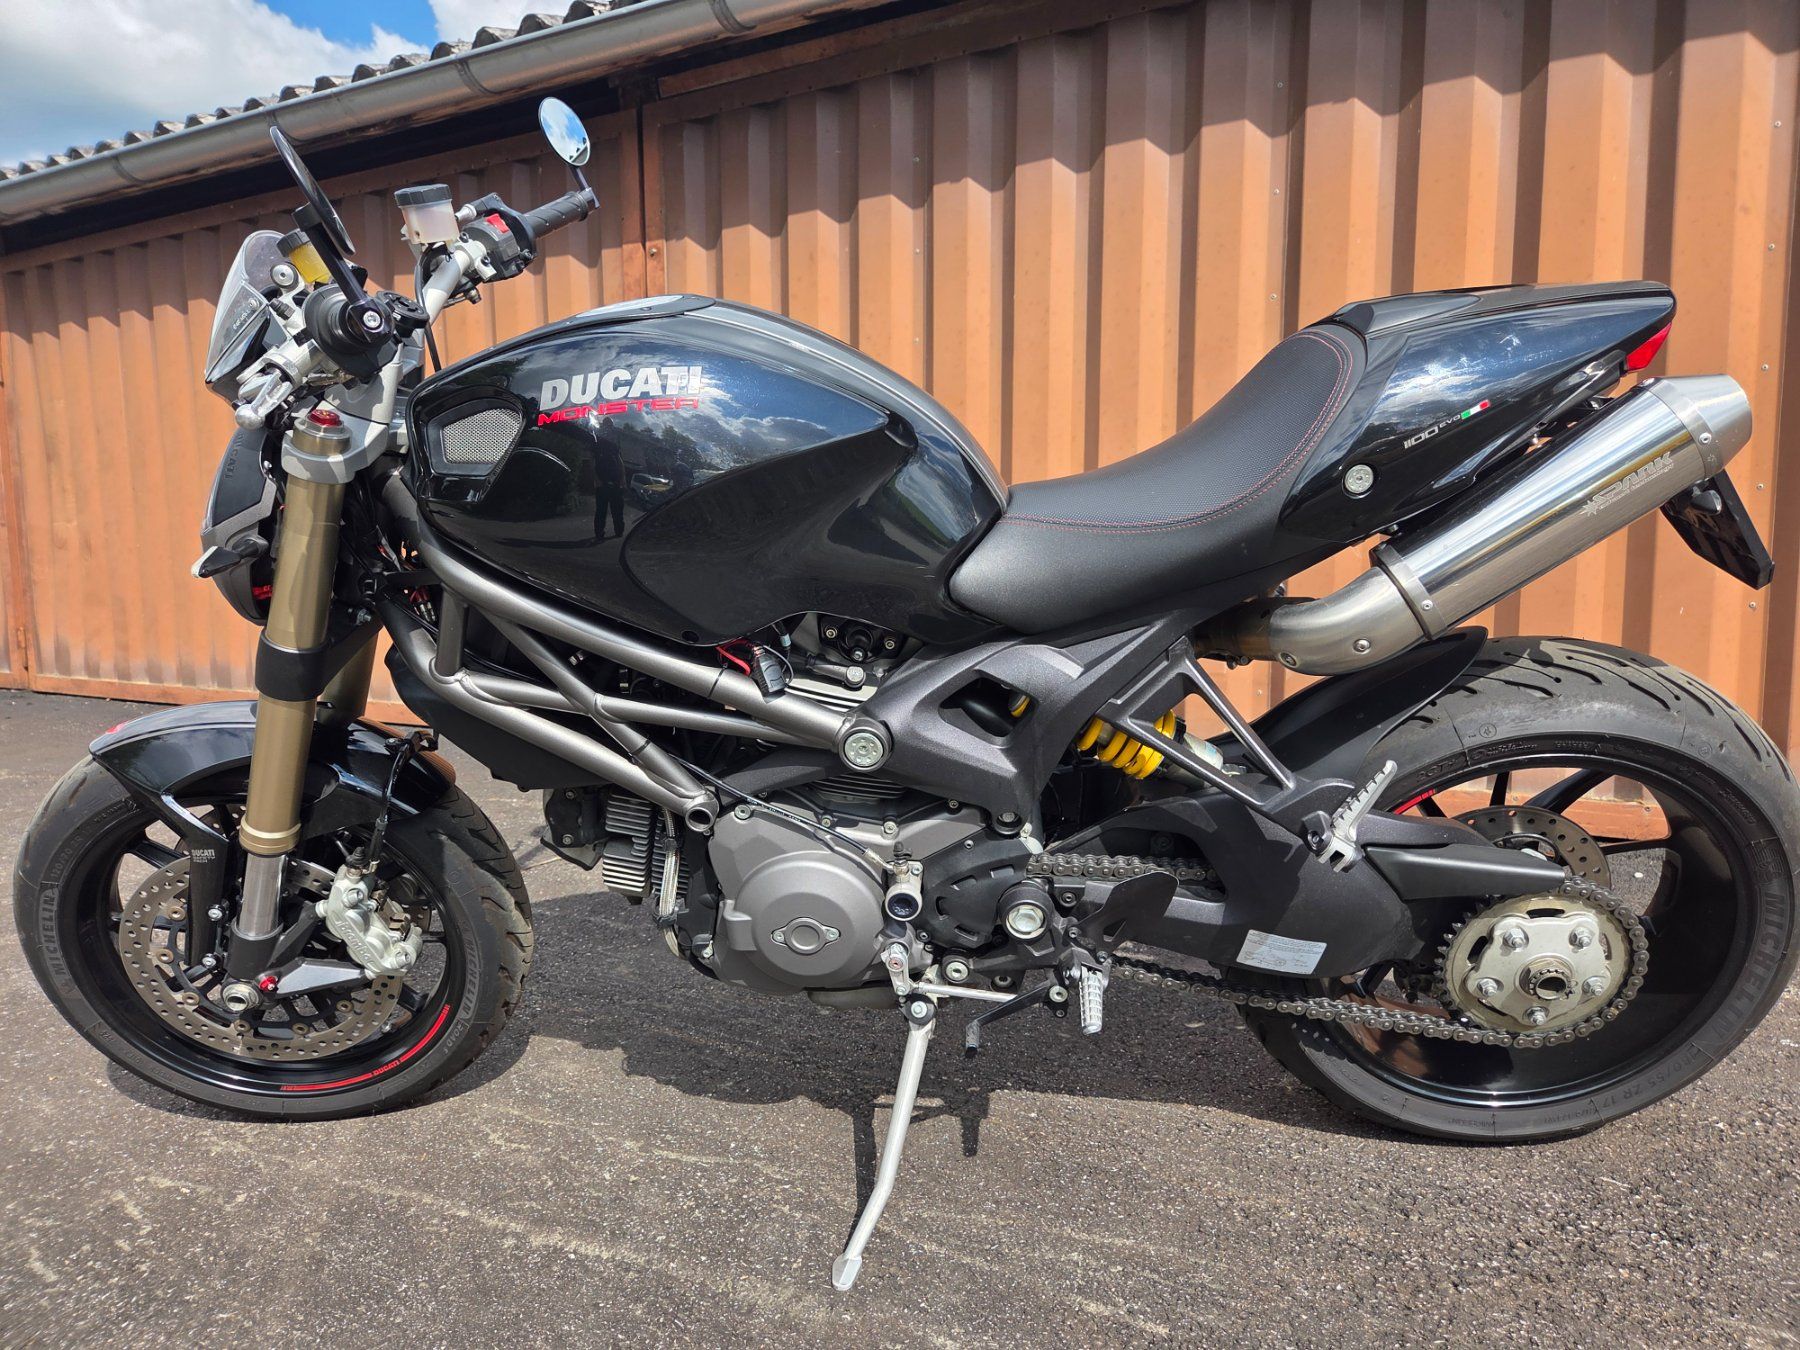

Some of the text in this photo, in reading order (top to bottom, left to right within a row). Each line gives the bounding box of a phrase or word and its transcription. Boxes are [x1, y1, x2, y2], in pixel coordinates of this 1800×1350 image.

[540, 366, 702, 411] DUCATI
[537, 397, 700, 426] MONSTER
[1404, 427, 1439, 449] 1100
[191, 849, 216, 857] DUCATI
[41, 890, 68, 977] MICHELIN
[463, 938, 480, 1015] MICHELIN
[1711, 891, 1786, 1038] MICHELIN
[372, 1060, 400, 1076] DUCATI
